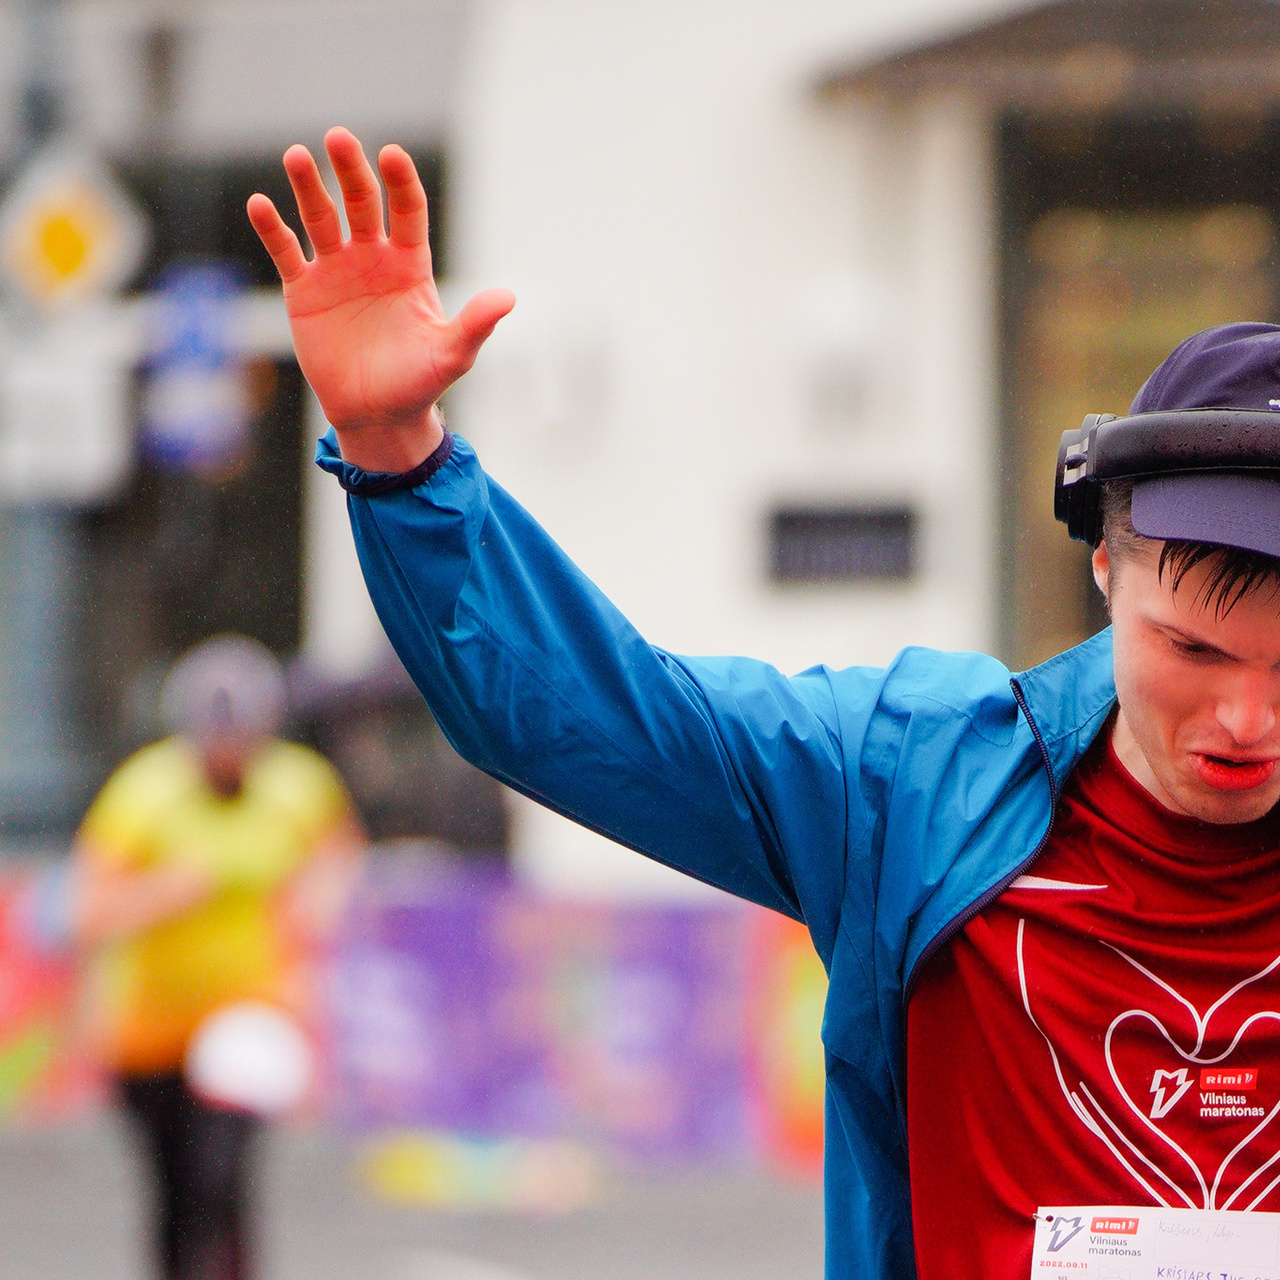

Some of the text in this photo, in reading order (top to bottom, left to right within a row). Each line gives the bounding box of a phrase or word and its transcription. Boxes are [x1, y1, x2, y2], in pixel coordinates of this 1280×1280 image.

[1200, 1092, 1247, 1106] Vilniaus
[1200, 1105, 1265, 1117] maratonas
[1089, 1236, 1128, 1247] Vilniaus
[1088, 1247, 1142, 1258] maratonas
